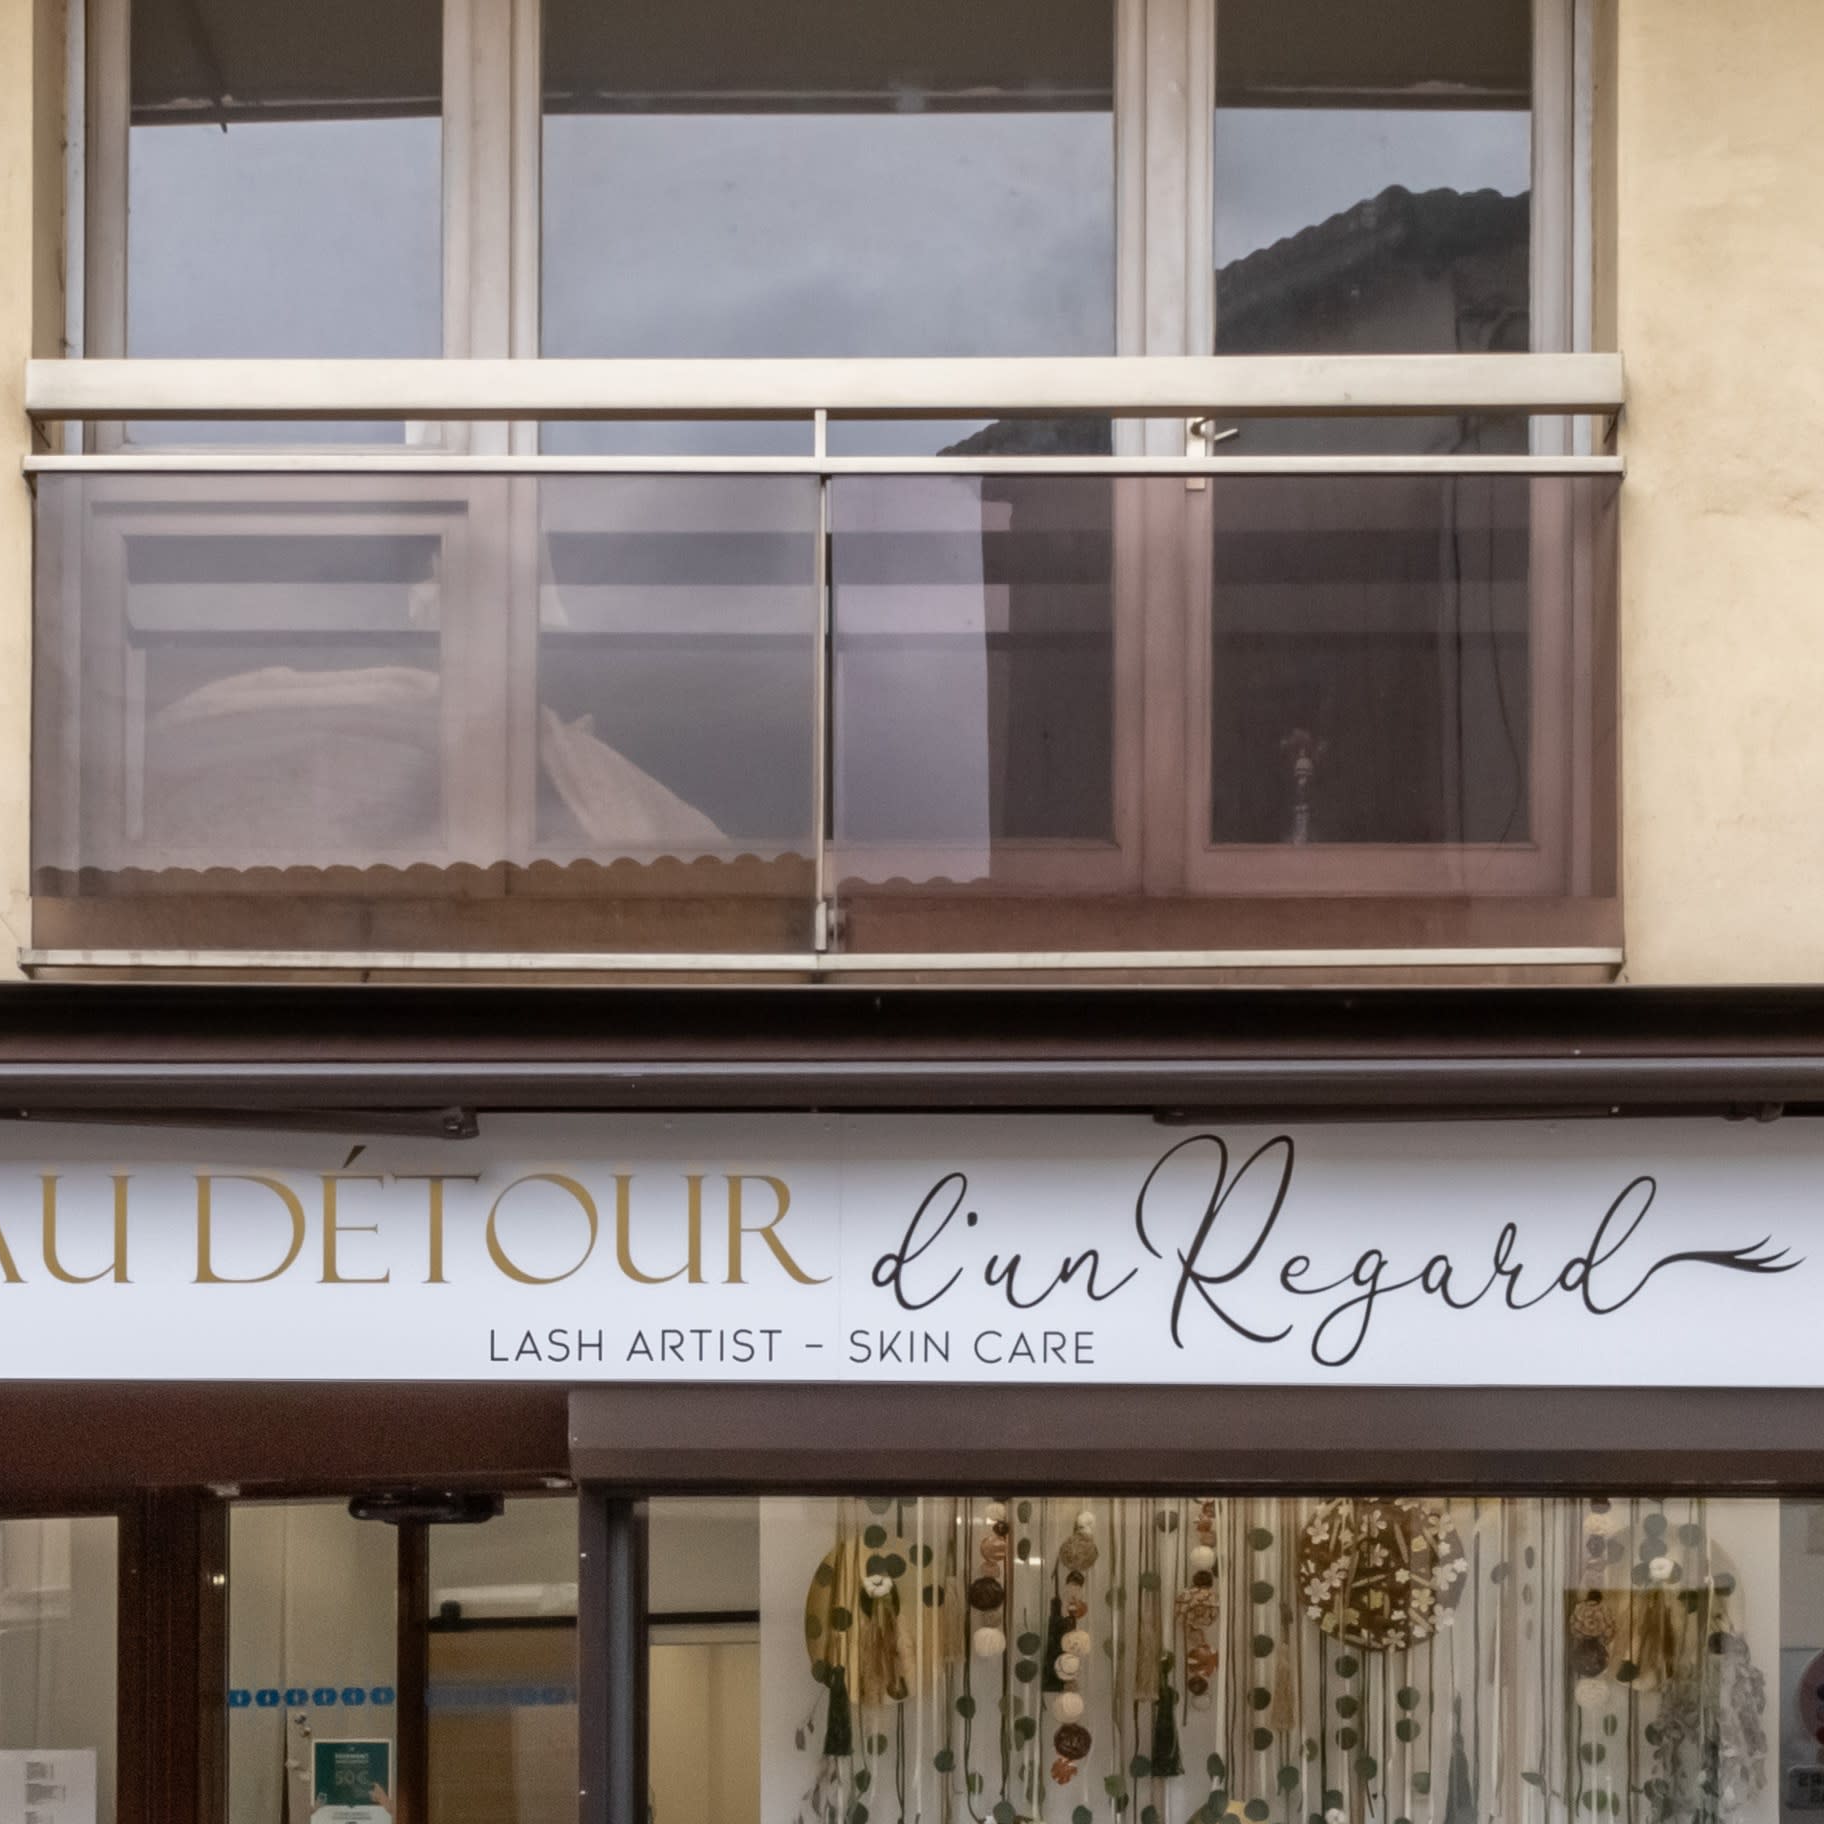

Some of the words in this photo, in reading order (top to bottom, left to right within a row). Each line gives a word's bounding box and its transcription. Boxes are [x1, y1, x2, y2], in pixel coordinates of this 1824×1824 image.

[190, 1145, 833, 1285] DÉTOUR
[1134, 1134, 1676, 1367] Regard
[489, 1328, 604, 1363] LASH
[625, 1328, 783, 1363] ARTIST
[849, 1329, 950, 1364] SKIN
[973, 1330, 1096, 1365] CARE
